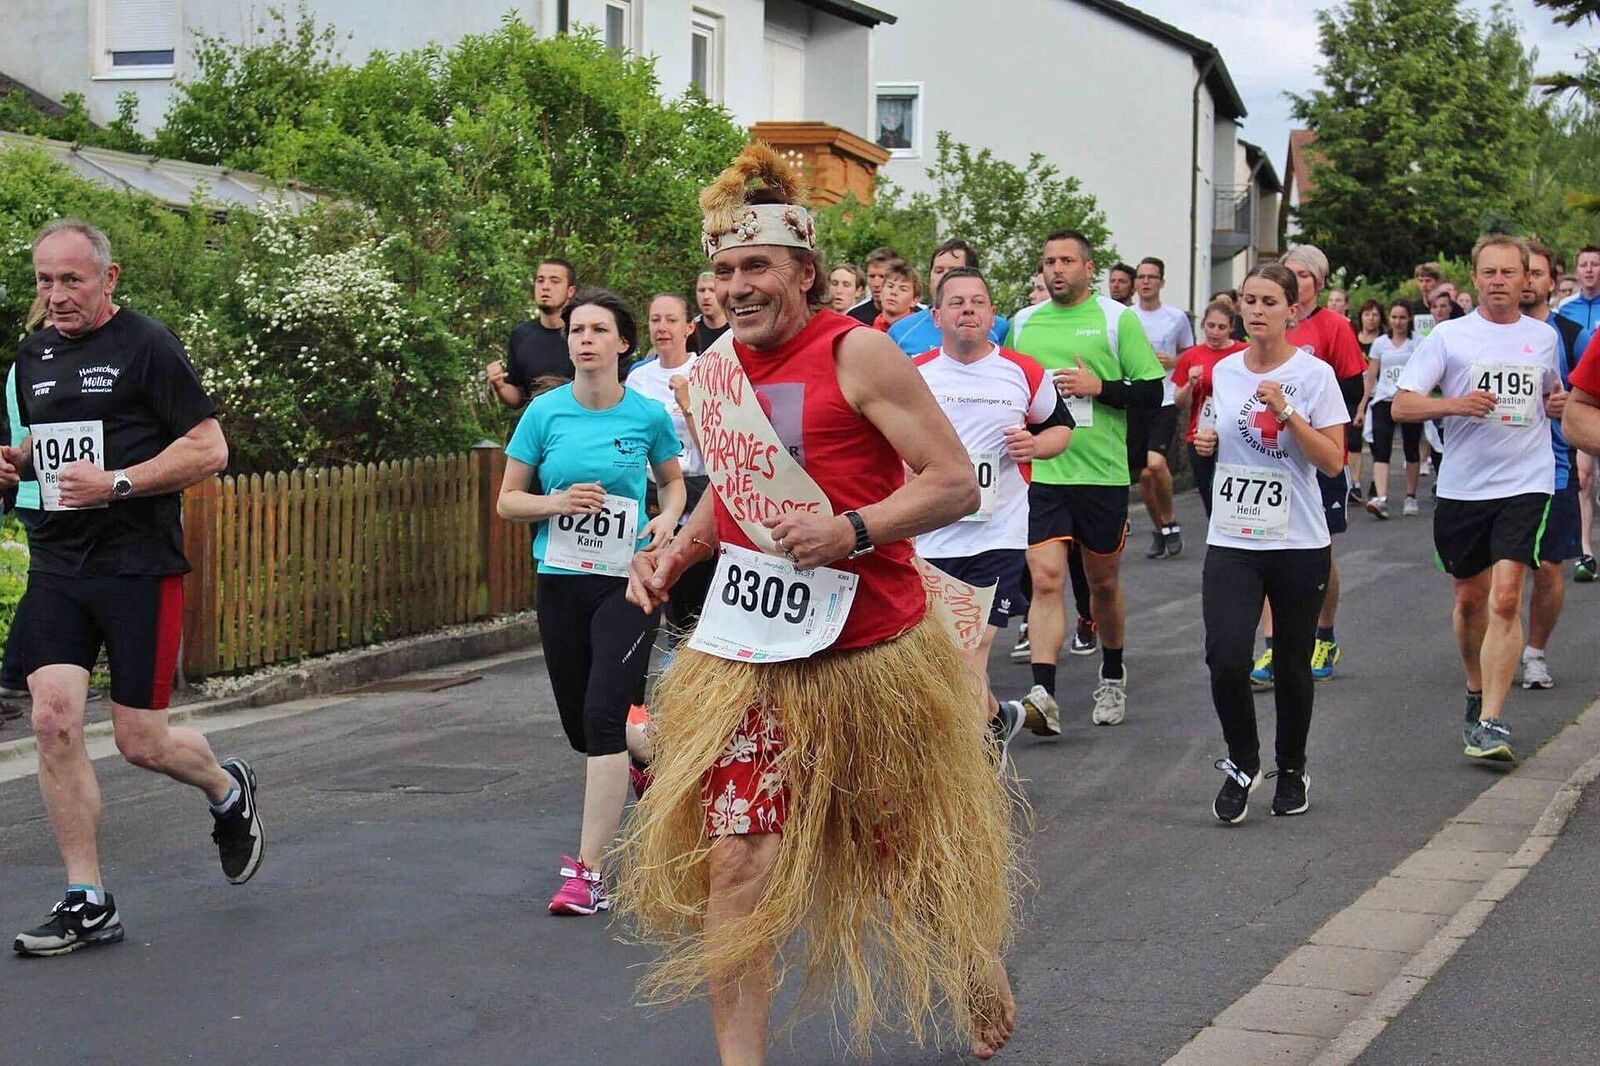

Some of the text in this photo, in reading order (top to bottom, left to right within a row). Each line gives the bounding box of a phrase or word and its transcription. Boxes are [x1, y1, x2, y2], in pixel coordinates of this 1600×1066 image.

[1477, 371, 1534, 396] 4195
[701, 399, 722, 427] DAS
[1498, 396, 1526, 405] bastian
[35, 436, 95, 471] 1948
[702, 426, 779, 481] PARADIES
[45, 472, 58, 484] Rei
[1219, 476, 1283, 508] 4773
[1236, 505, 1261, 516] Heidi
[577, 535, 604, 549] Karin
[721, 564, 811, 625] 8309
